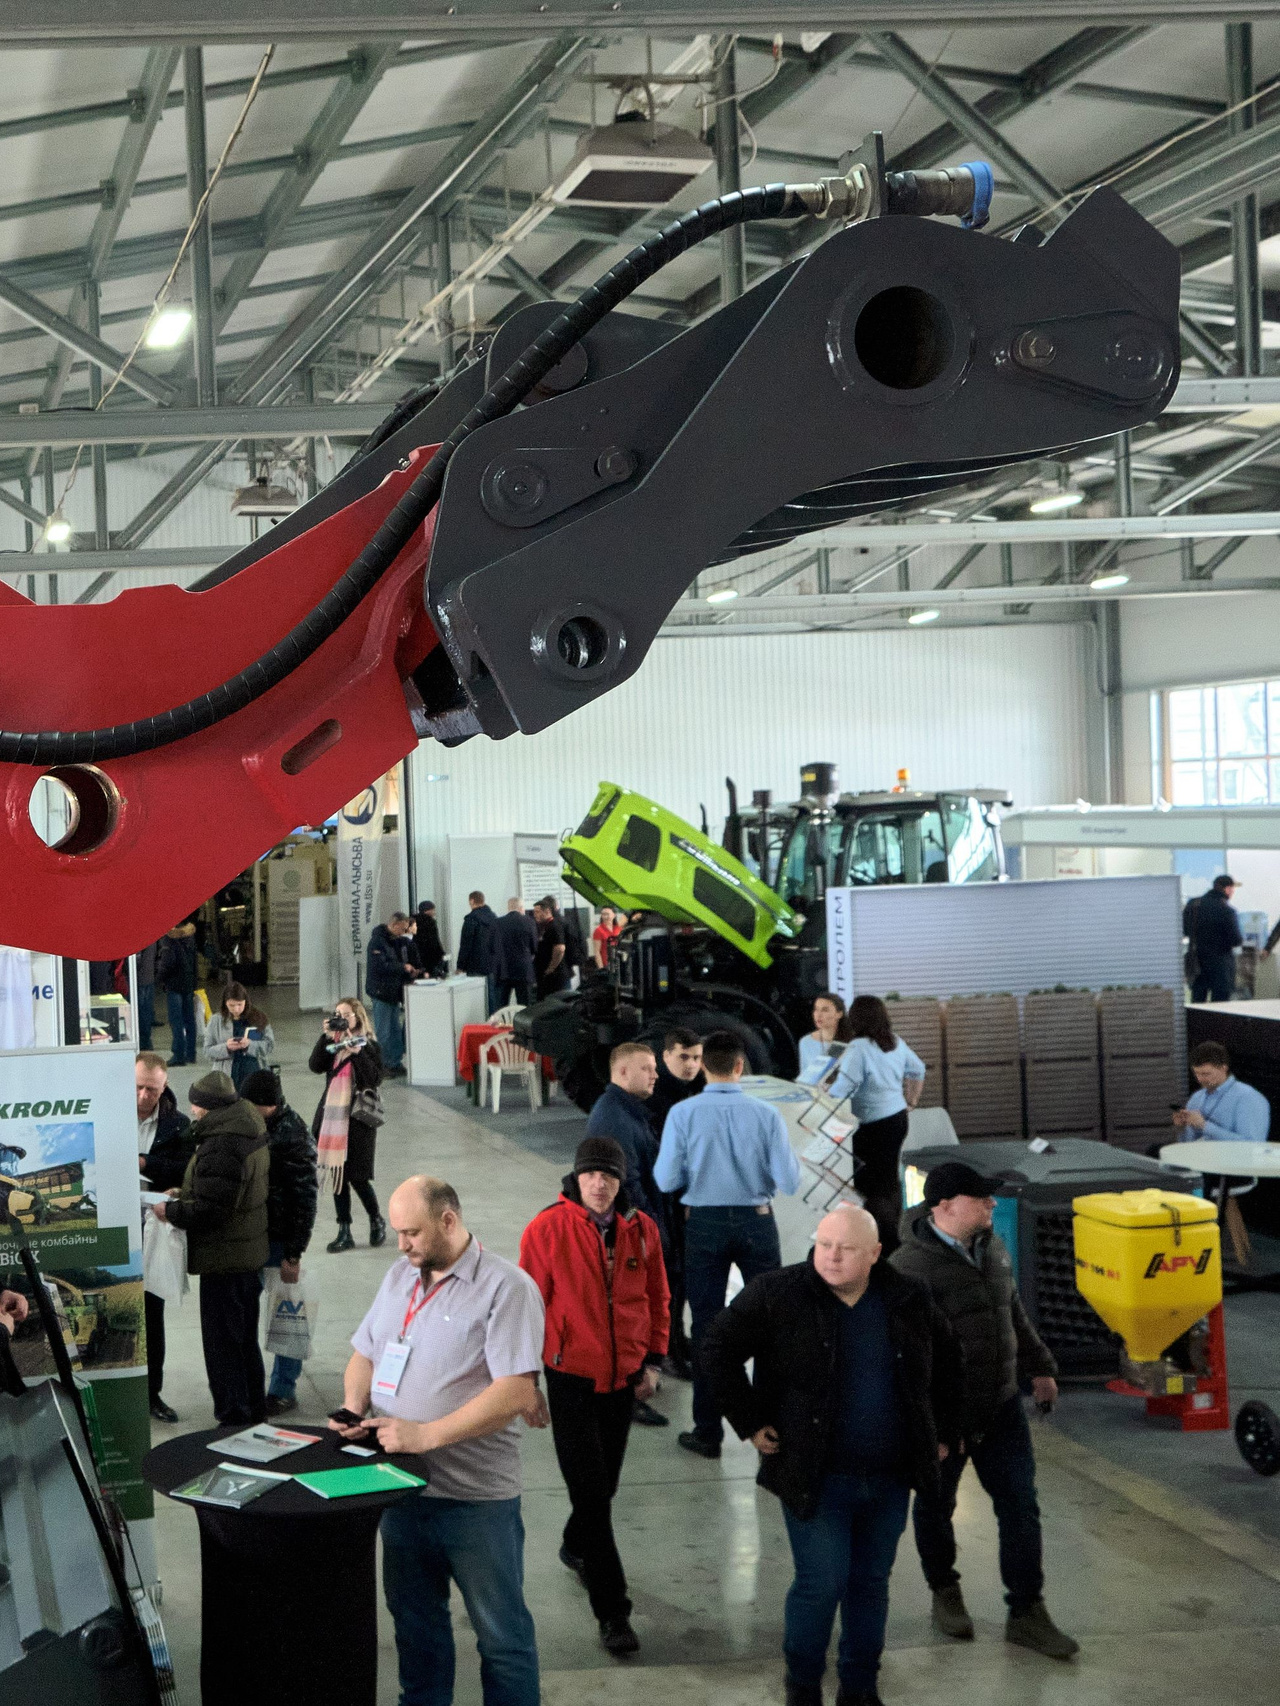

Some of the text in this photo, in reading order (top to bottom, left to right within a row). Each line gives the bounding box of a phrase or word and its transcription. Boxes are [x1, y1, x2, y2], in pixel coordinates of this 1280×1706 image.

[350, 836, 363, 955] ТЕРМИНАЛ-ЛЫСЬВА
[834, 896, 846, 992] ТРОЛЕМ
[40, 1234, 98, 1248] комбайны
[1144, 1248, 1213, 1279] APV
